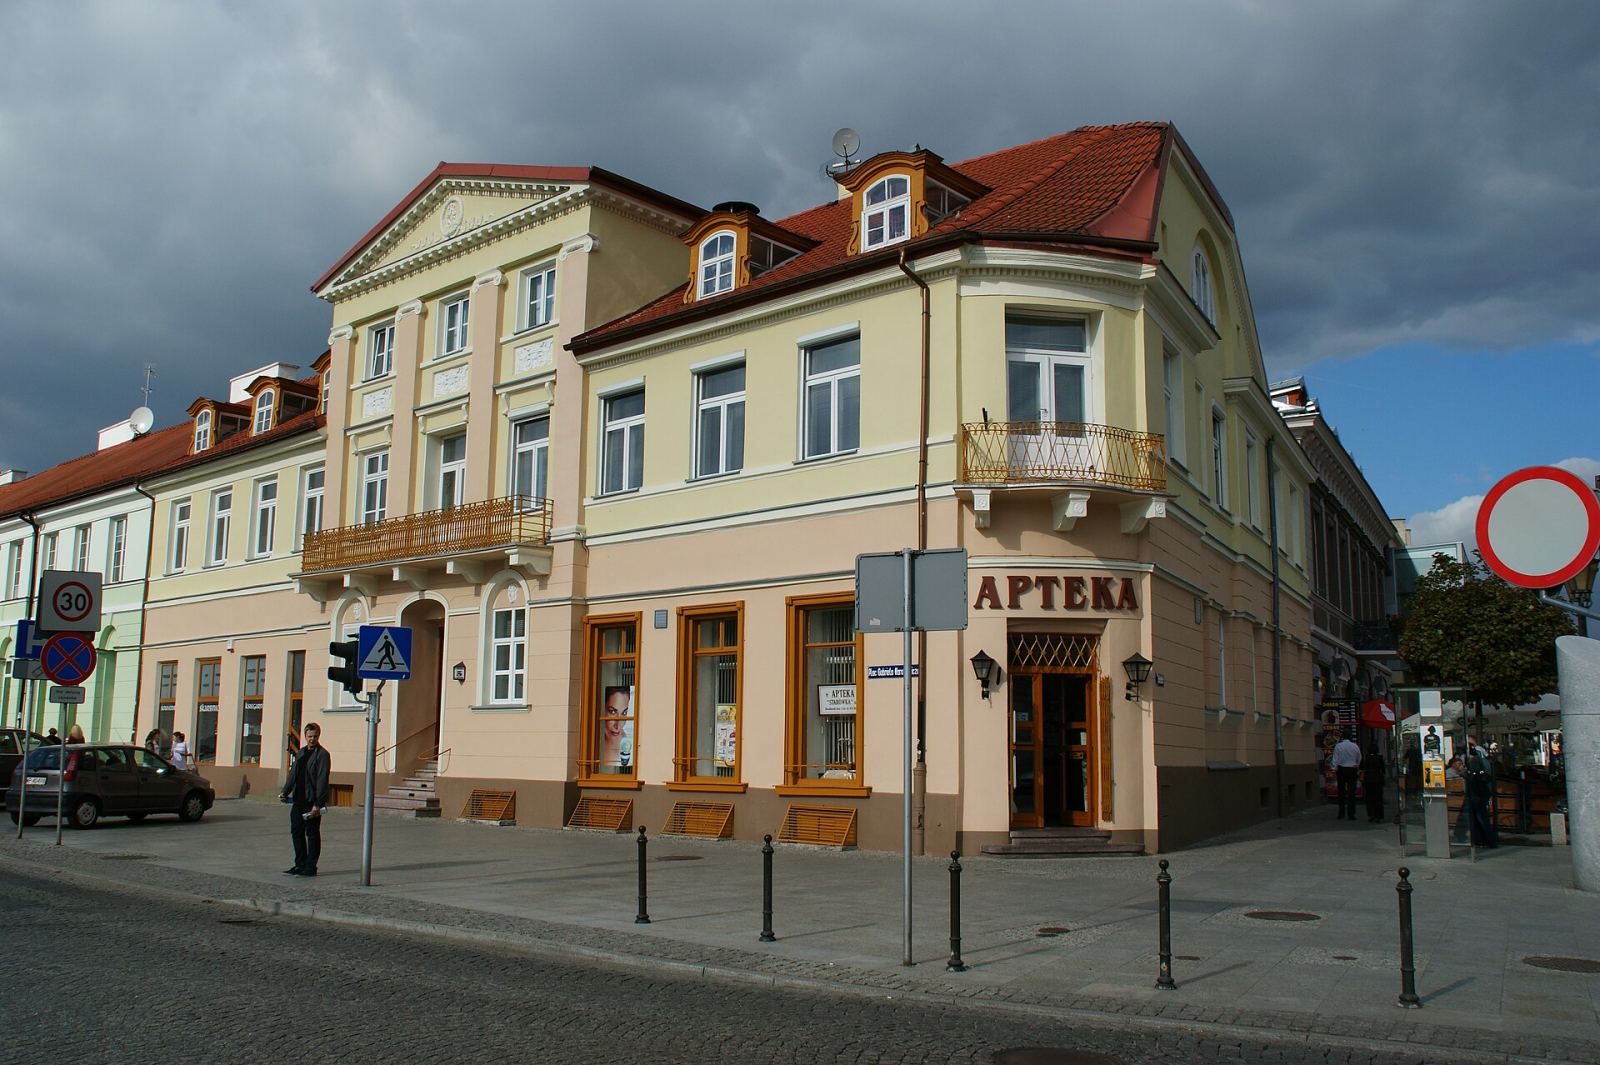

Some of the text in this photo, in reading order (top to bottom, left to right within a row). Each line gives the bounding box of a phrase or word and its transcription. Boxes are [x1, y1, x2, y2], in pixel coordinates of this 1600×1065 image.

[60, 592, 86, 611] 30
[973, 575, 1139, 610] APTEKA
[832, 690, 855, 698] APTEKA
